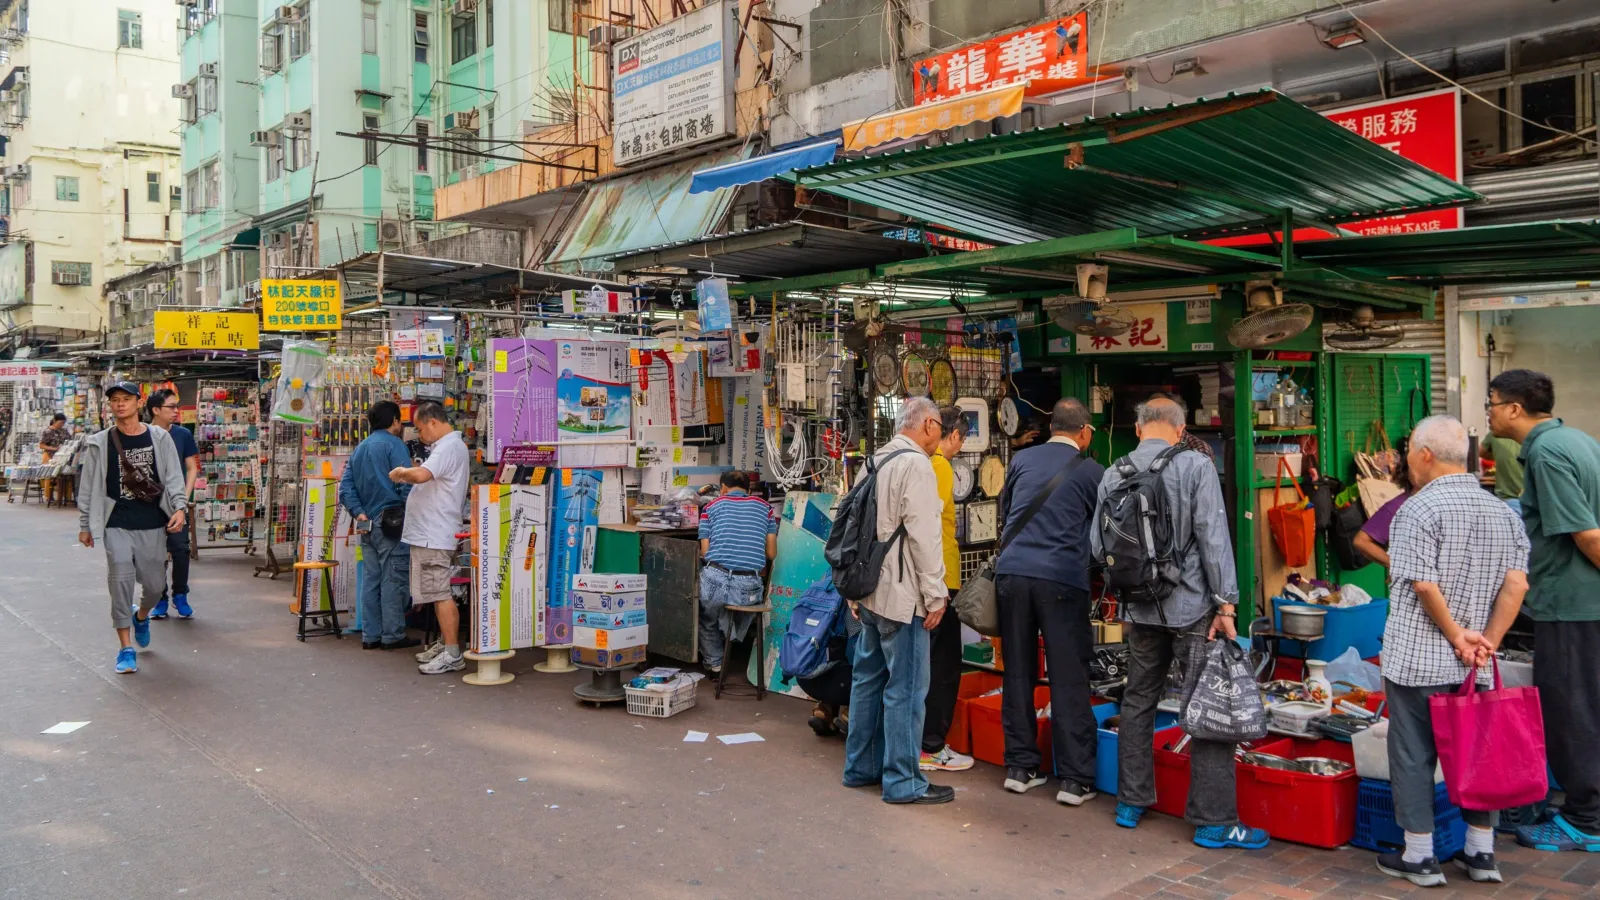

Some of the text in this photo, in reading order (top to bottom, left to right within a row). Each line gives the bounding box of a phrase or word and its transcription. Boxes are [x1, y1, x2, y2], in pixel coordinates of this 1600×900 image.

[641, 28, 676, 46] High Technology
[641, 23, 712, 56] Information and Communication
[622, 44, 636, 62] DX
[640, 54, 658, 66] Products
[946, 30, 1047, 90] 龍華
[692, 70, 714, 82] EQUIPMENT
[689, 82, 711, 94] EQUIPMENT
[620, 134, 642, 158] 新昌
[267, 285, 336, 298] 林記天線行
[187, 314, 230, 329] 祥記
[172, 331, 244, 346] 電話咭
[1202, 720, 1236, 734] CINNAMON
[1242, 724, 1261, 733] BARK
[1228, 826, 1246, 842] N
